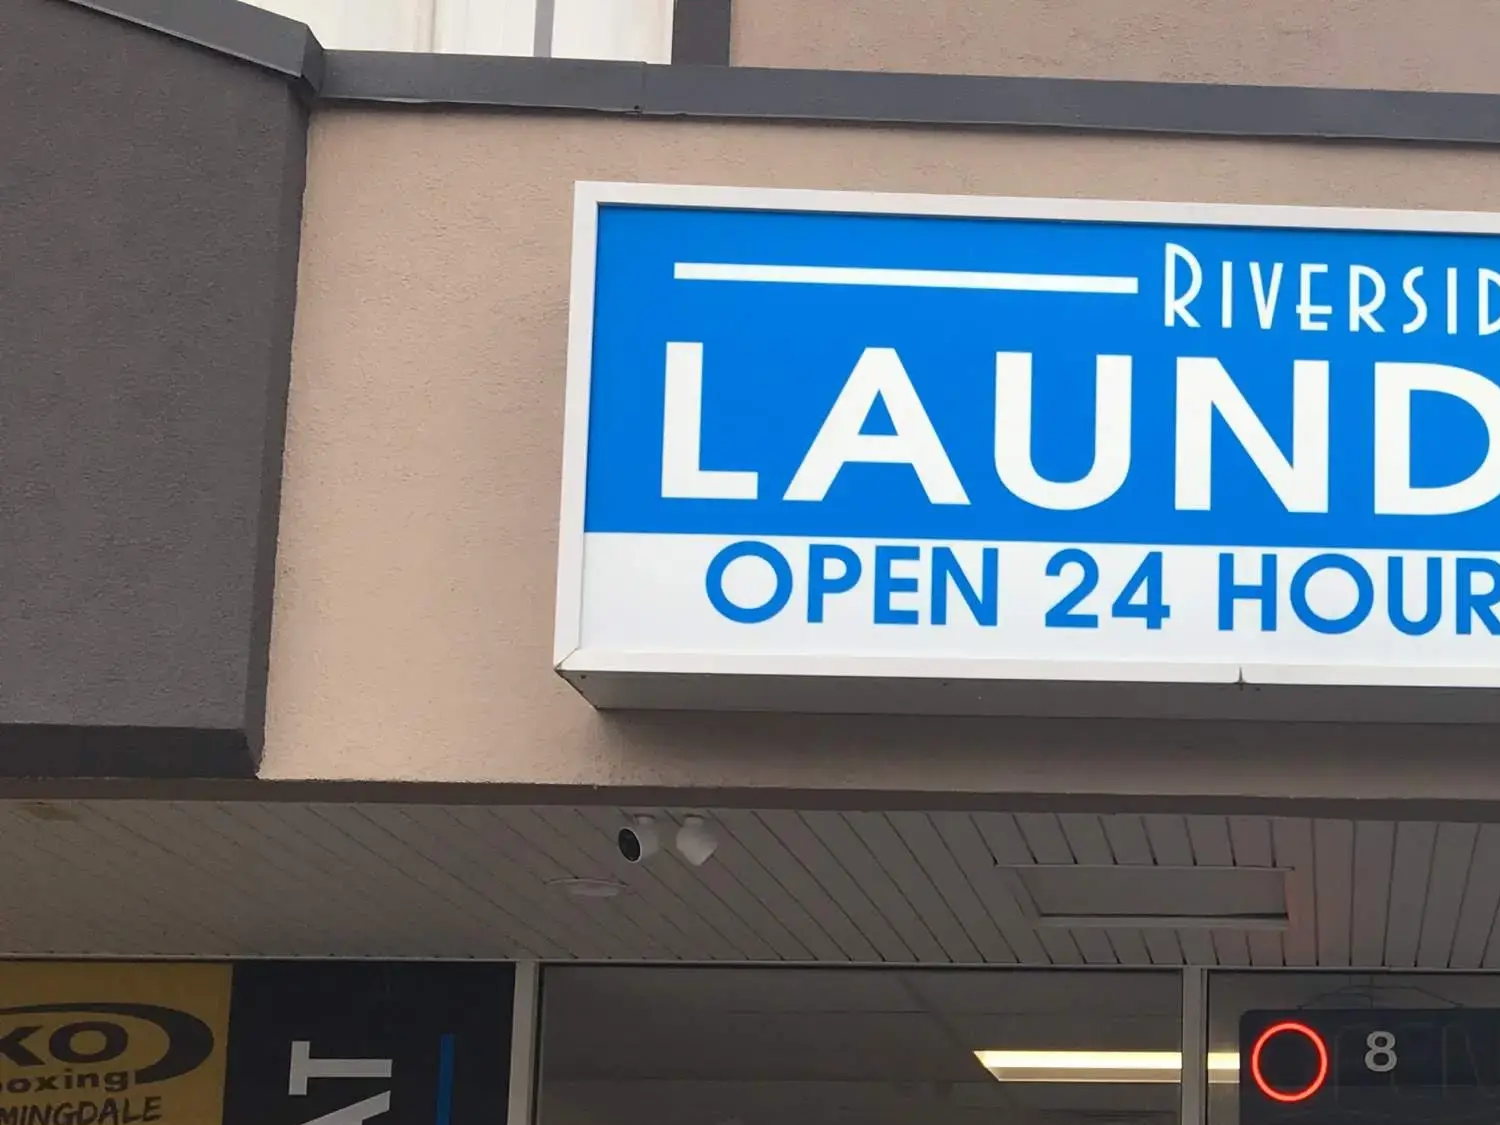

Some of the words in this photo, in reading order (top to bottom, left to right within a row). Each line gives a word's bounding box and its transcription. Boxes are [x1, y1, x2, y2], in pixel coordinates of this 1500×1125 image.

[706, 540, 999, 626] OPEN
[1045, 548, 1170, 629] 24
[1362, 1029, 1400, 1074] 8
[0, 1069, 128, 1093] oxing
